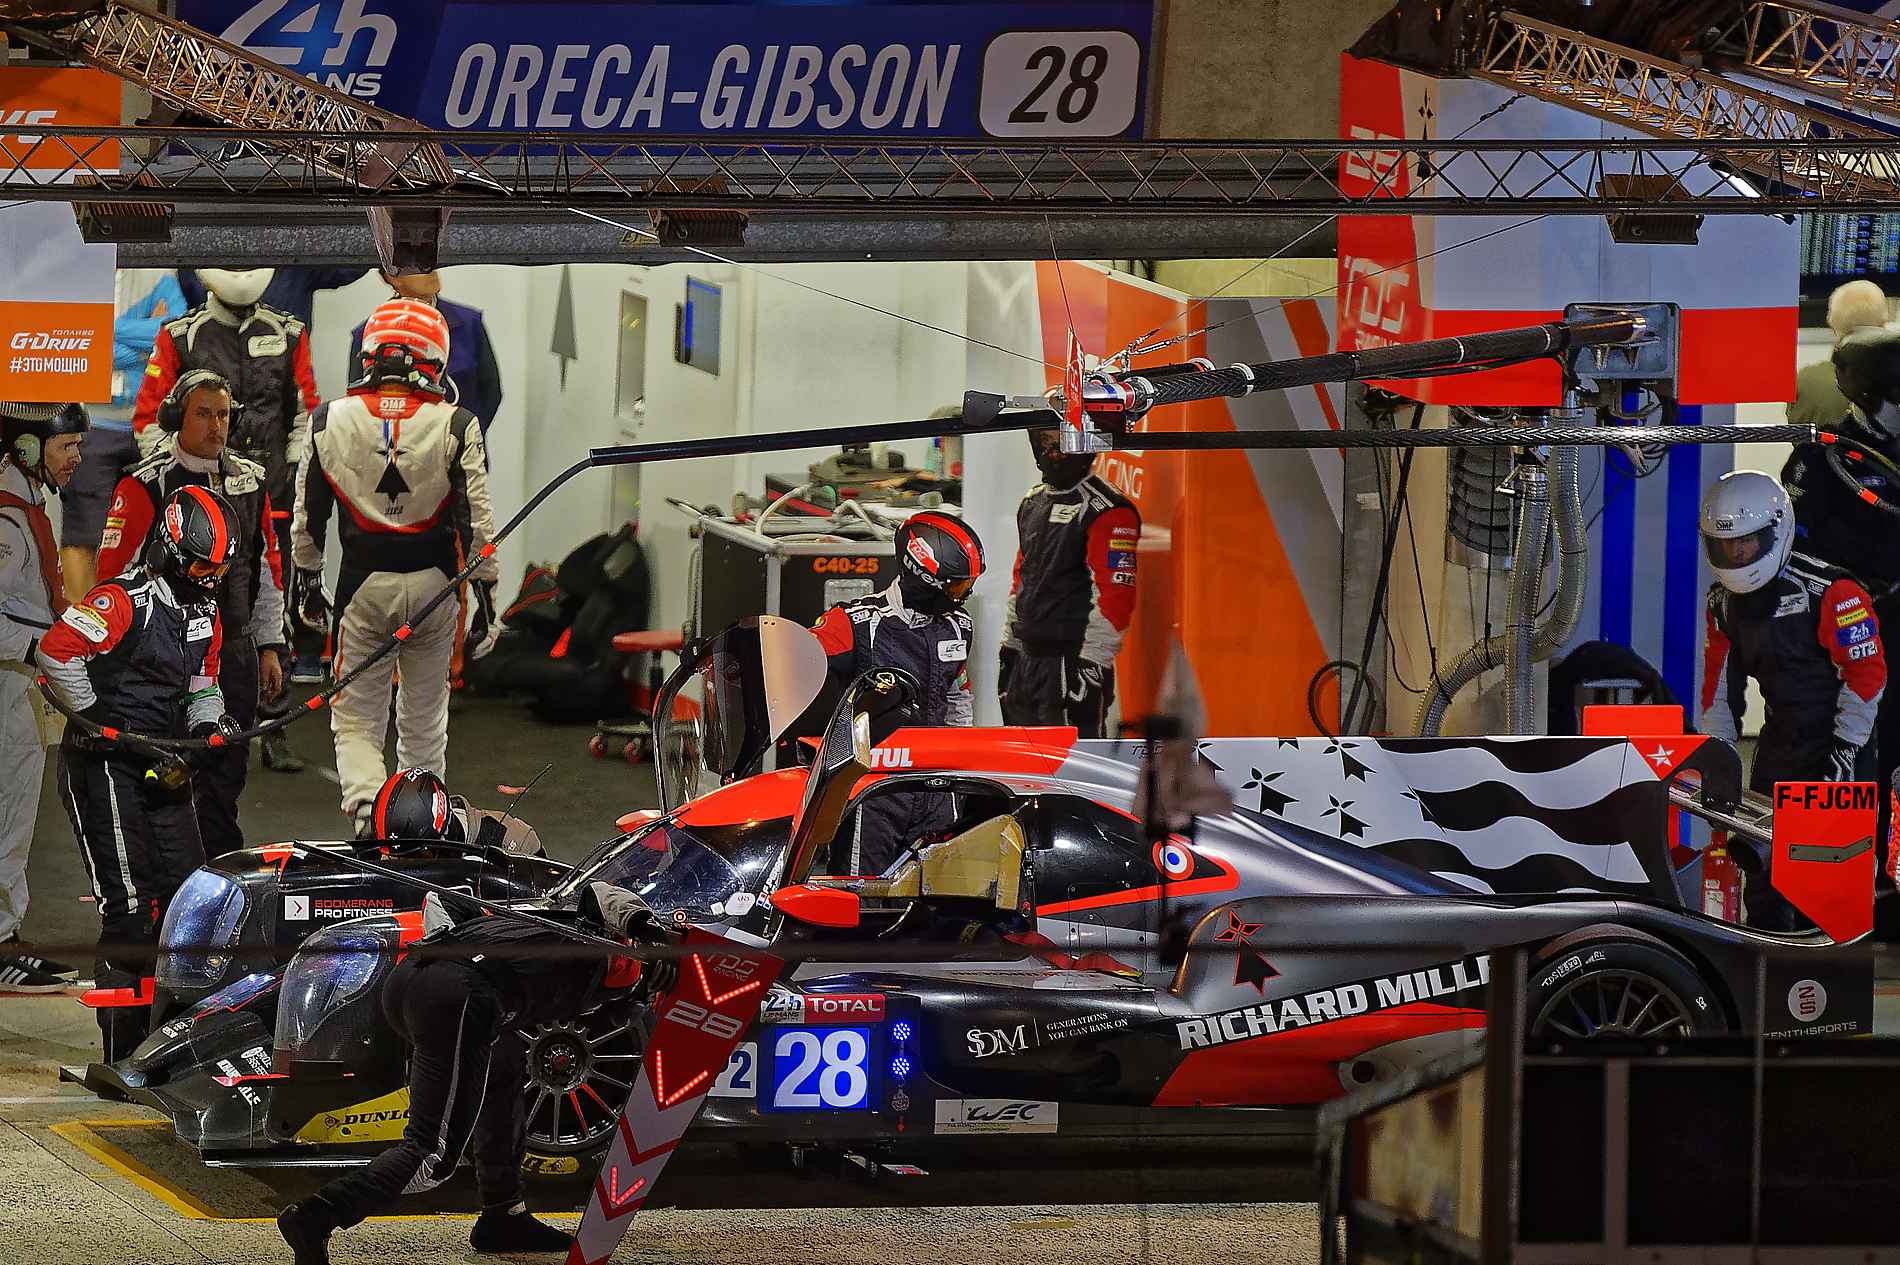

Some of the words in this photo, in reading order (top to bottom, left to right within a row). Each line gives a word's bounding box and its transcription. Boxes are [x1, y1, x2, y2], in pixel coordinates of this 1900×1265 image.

[444, 42, 962, 131] ORECA-GIBSON
[1008, 44, 1109, 124] 28
[813, 556, 880, 575] C40-25
[903, 554, 945, 590] uvex
[1777, 785, 1875, 810] F-FJCM
[315, 899, 393, 909] BOOMERANG
[664, 1000, 743, 1040] 28
[807, 997, 881, 1014] TOTAL
[1176, 983, 1370, 1050] RICHARD
[1046, 1013, 1108, 1031] GENERATIONS
[1048, 1030, 1068, 1041] YOU
[1070, 1027, 1088, 1037] CAN
[1090, 1021, 1114, 1034] BANK
[1115, 1018, 1129, 1028] ON
[966, 1025, 1029, 1058] SDM
[774, 1030, 868, 1107] 28
[967, 1103, 1041, 1121] WEC
